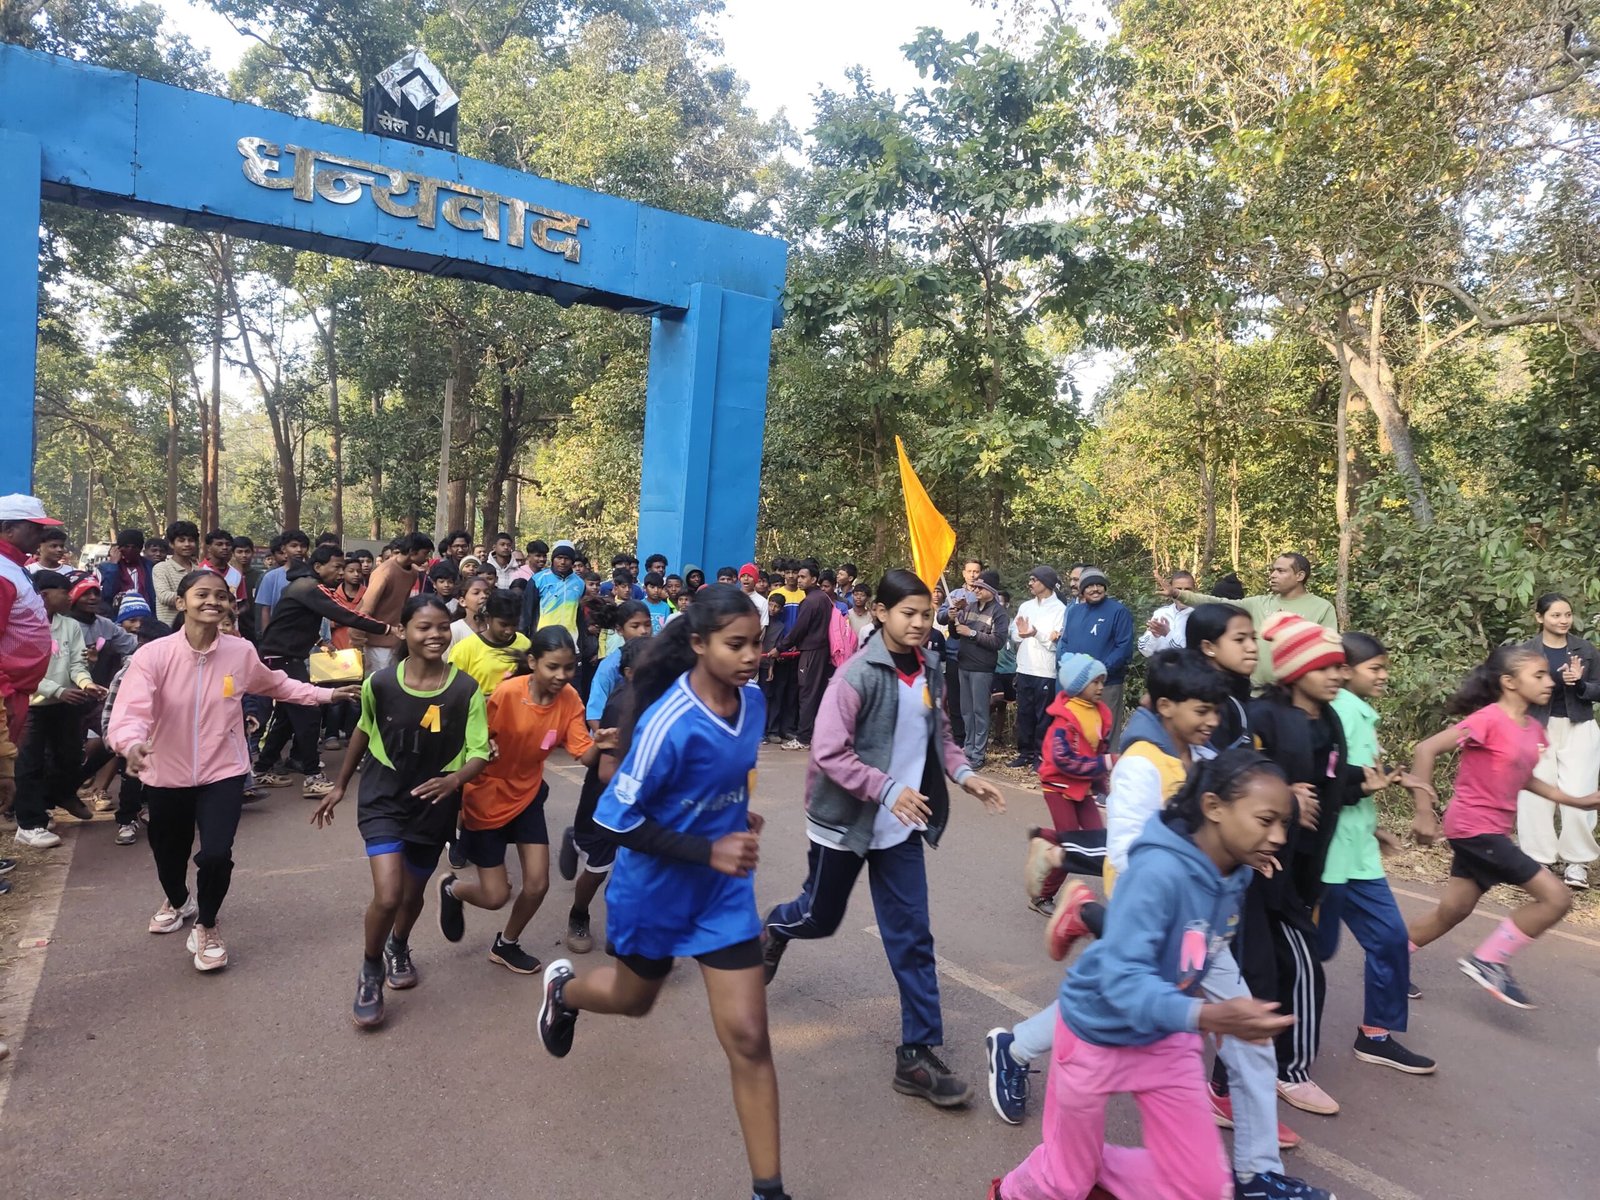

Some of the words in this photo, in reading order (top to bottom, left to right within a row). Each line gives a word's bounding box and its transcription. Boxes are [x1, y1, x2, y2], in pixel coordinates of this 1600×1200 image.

[377, 111, 409, 135] सेल
[416, 125, 454, 147] SAIL
[236, 136, 590, 264] धन्यवाद
